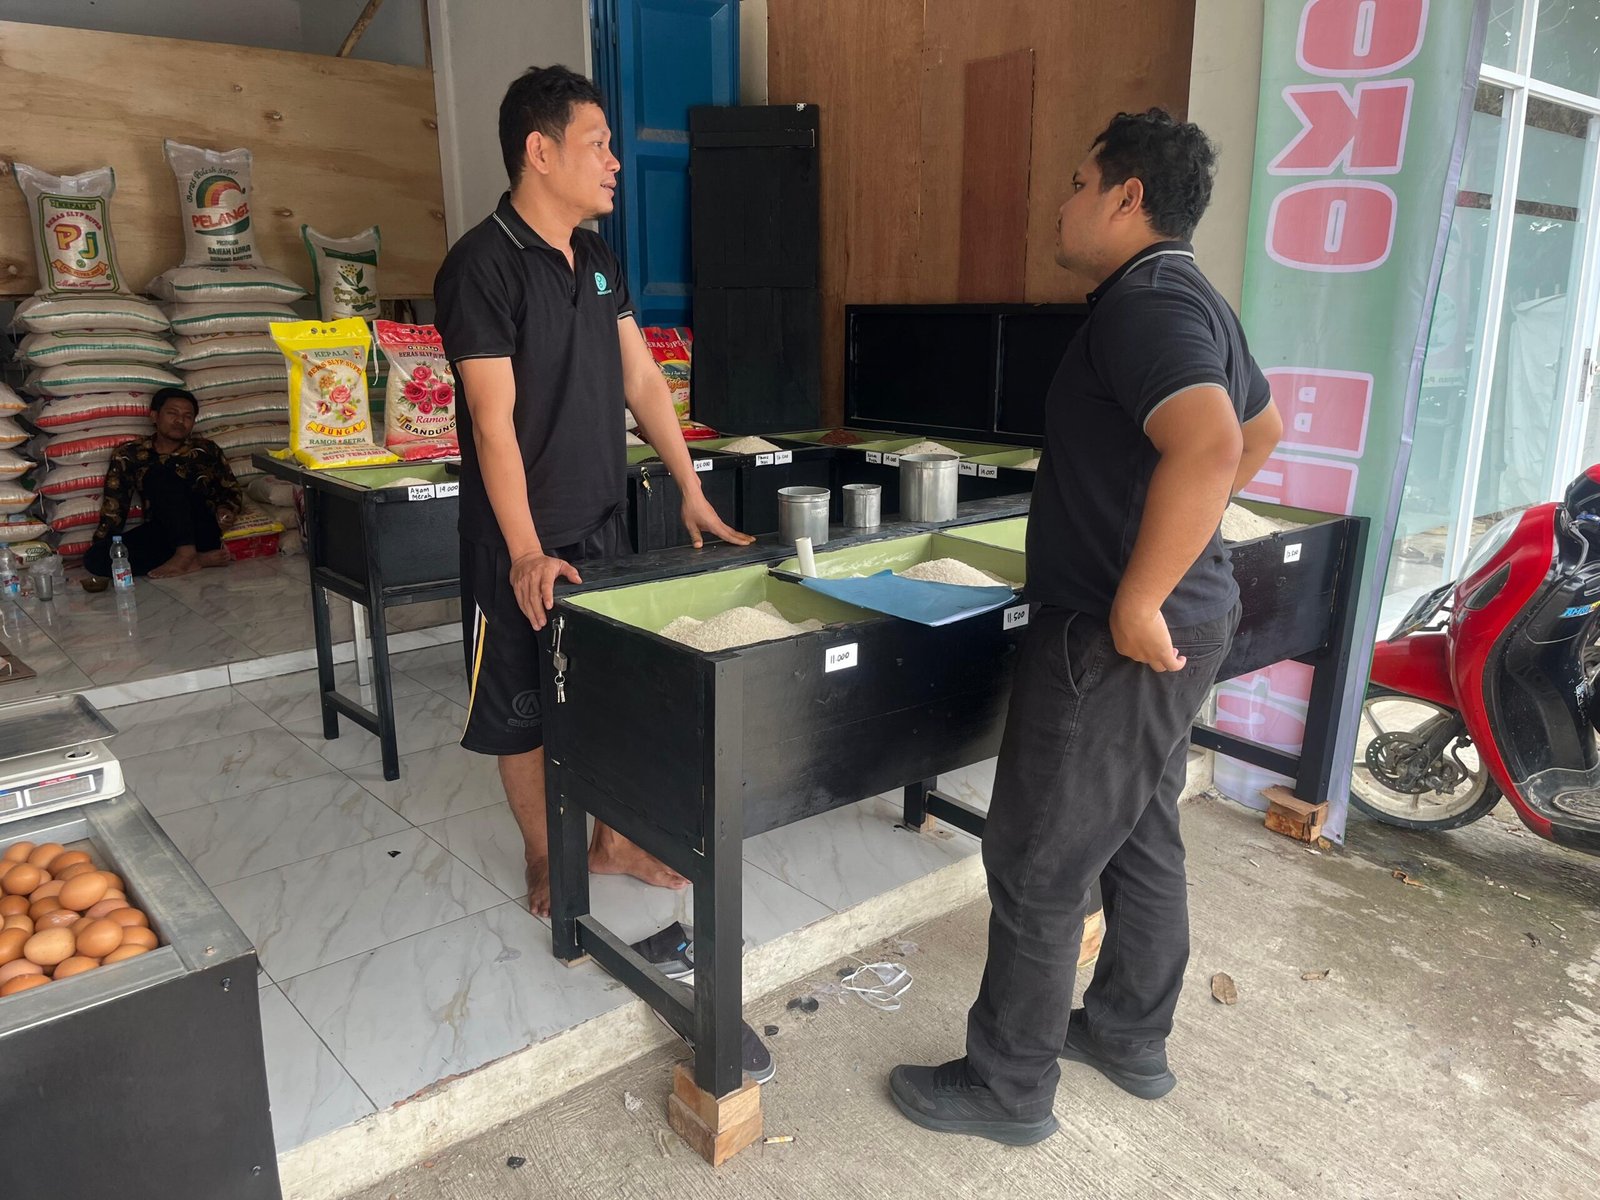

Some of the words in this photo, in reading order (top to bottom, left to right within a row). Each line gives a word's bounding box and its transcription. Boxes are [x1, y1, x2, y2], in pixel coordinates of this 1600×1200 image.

[191, 202, 249, 229] PELANGI
[314, 350, 349, 358] KEPALA
[308, 361, 326, 377] BERAS
[416, 415, 448, 424] Ramos
[320, 426, 358, 435] BUNGA
[405, 421, 455, 436] BANDUNG
[410, 487, 430, 495] Ayam
[1007, 610, 1026, 624] 11.500
[830, 651, 850, 664] 11.000
